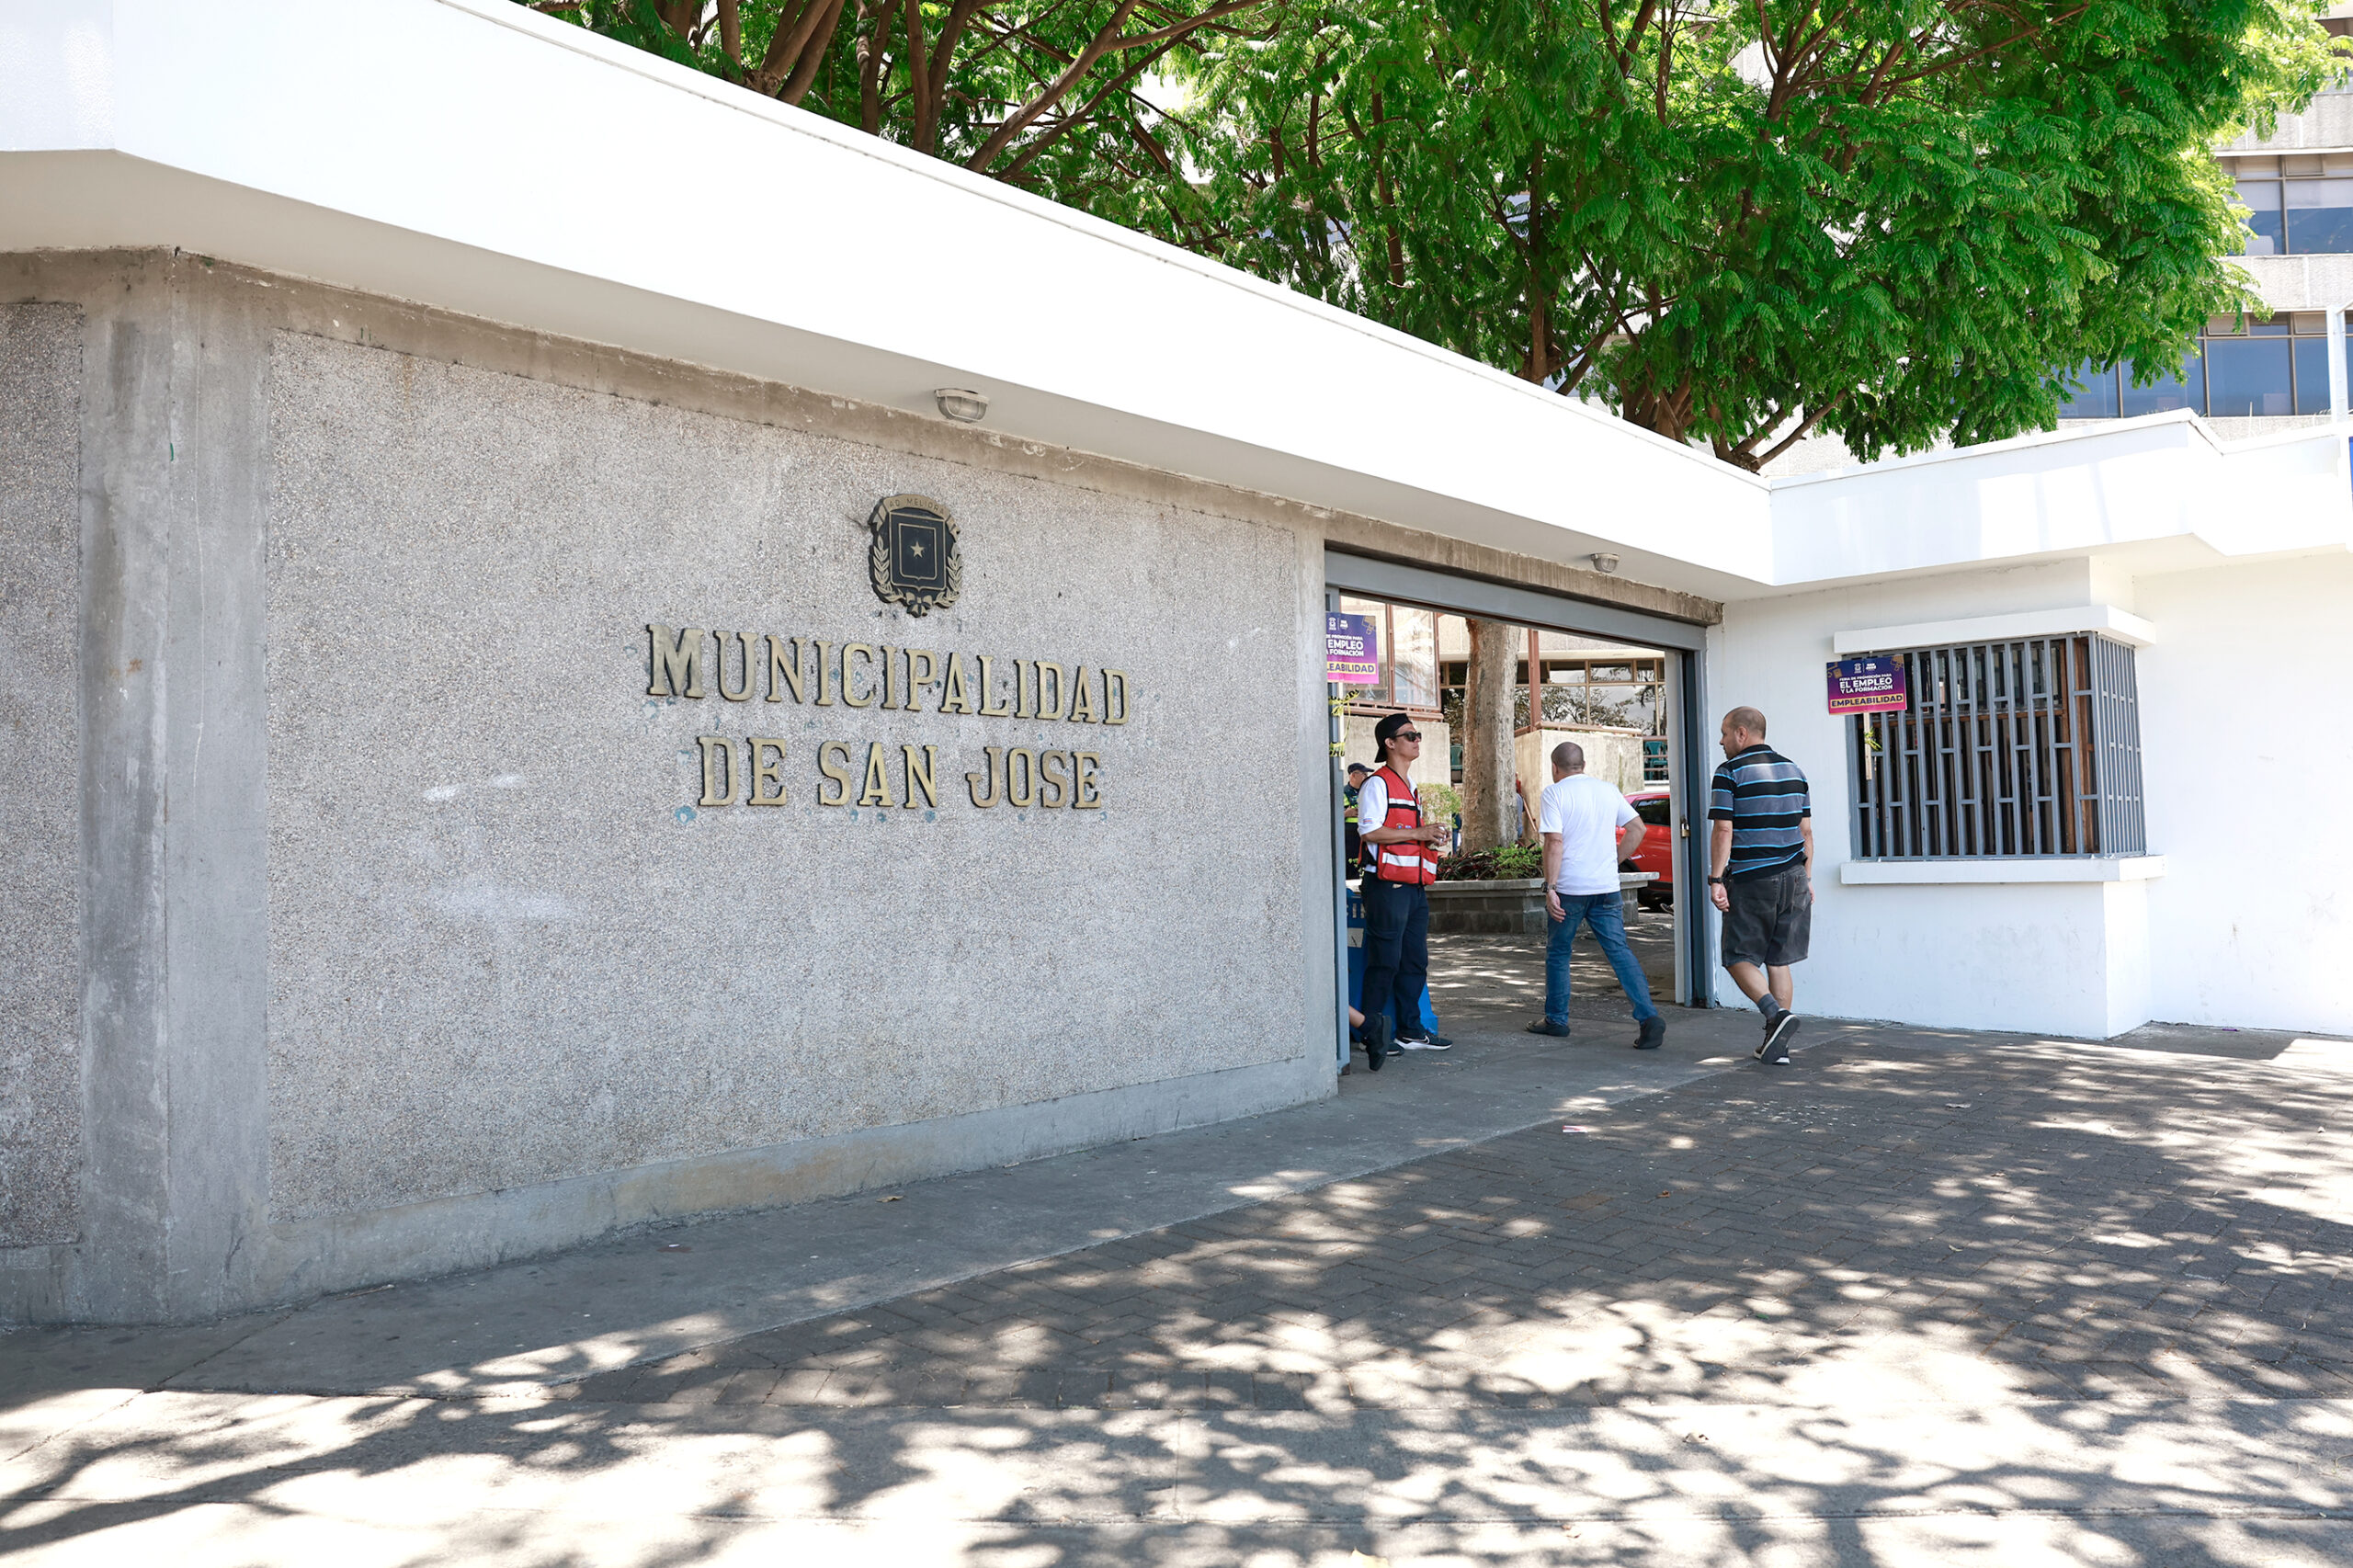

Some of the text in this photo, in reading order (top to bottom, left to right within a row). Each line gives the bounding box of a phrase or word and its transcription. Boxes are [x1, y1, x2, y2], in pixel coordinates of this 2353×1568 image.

[890, 498, 944, 514] AD MELIORA
[1327, 639, 1364, 650] EMPLEO
[646, 624, 1130, 725] MUNICIPALIDAD
[1327, 663, 1374, 673] EABILIDAD
[1839, 676, 1893, 689] EL EMPLEO
[1832, 695, 1903, 707] EMPLEABILIDAD
[697, 736, 1101, 809] DE SAN JOSE
